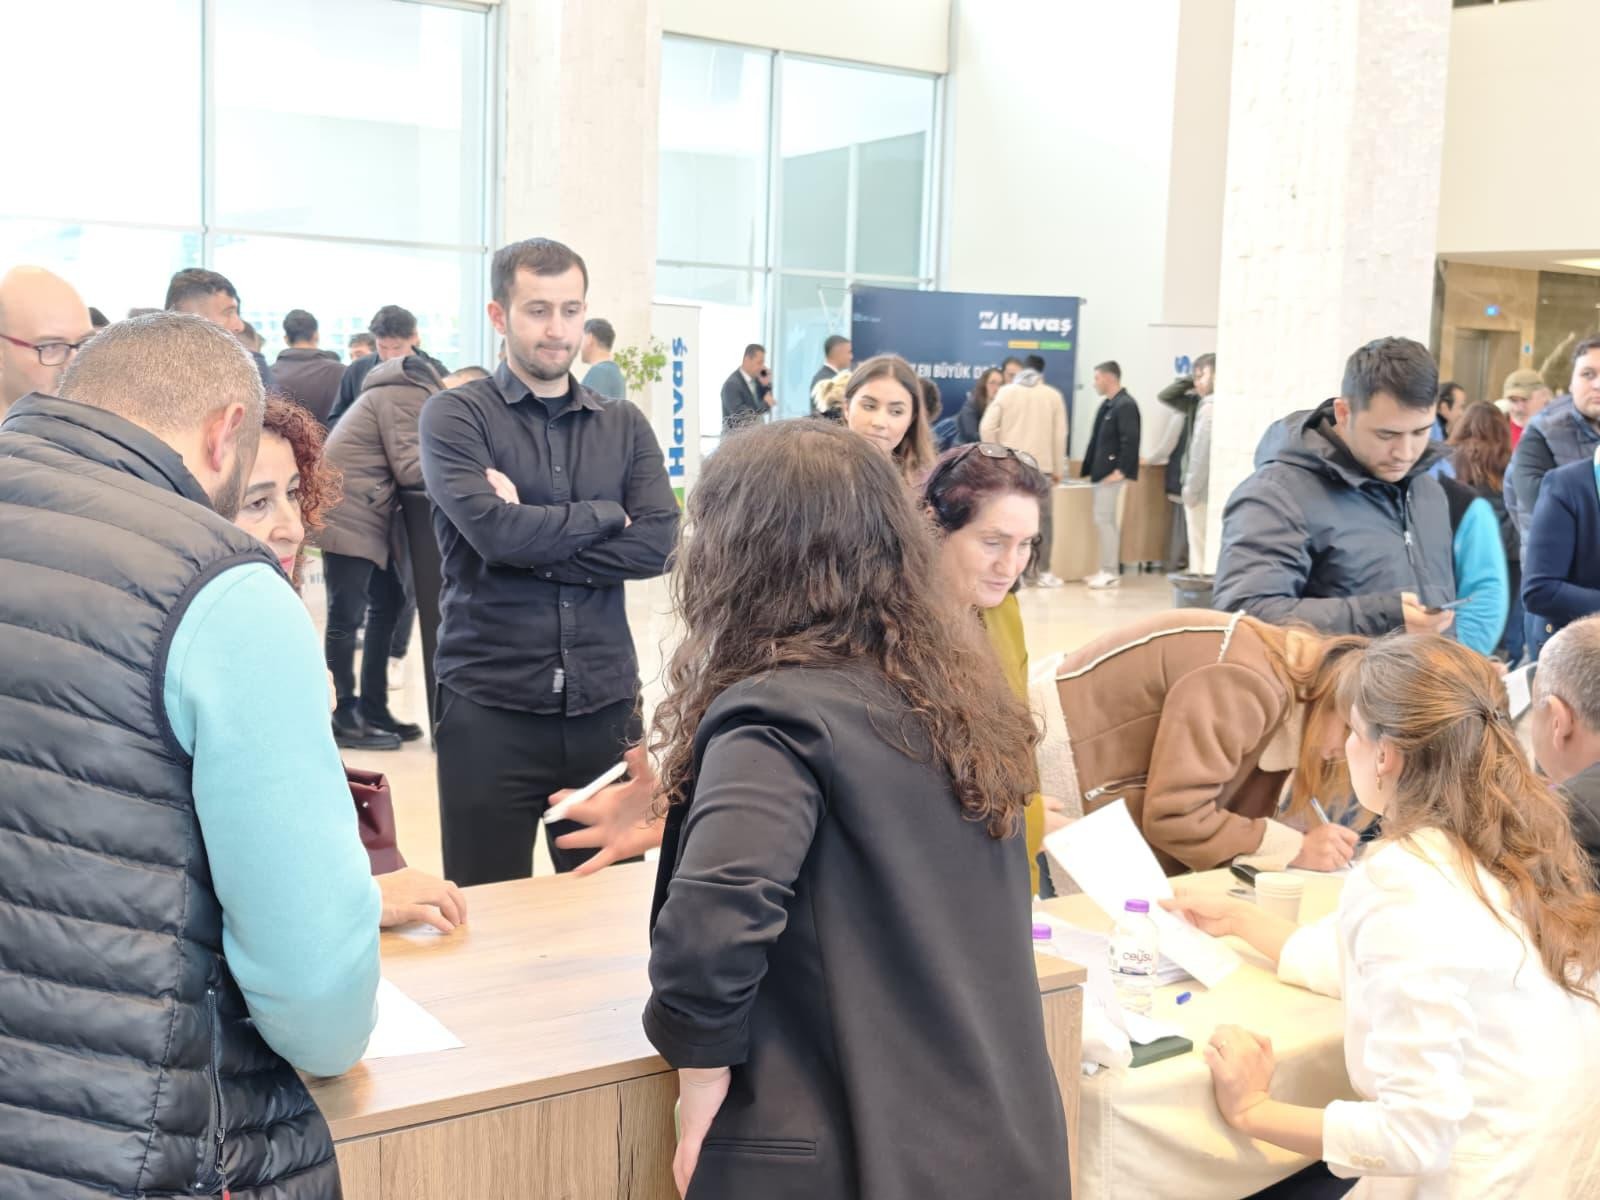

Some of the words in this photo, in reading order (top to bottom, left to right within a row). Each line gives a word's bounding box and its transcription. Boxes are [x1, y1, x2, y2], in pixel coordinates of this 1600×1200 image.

[1001, 312, 1072, 337] Havaş
[933, 361, 970, 379] BÜYÜK
[668, 337, 688, 476] Havaş
